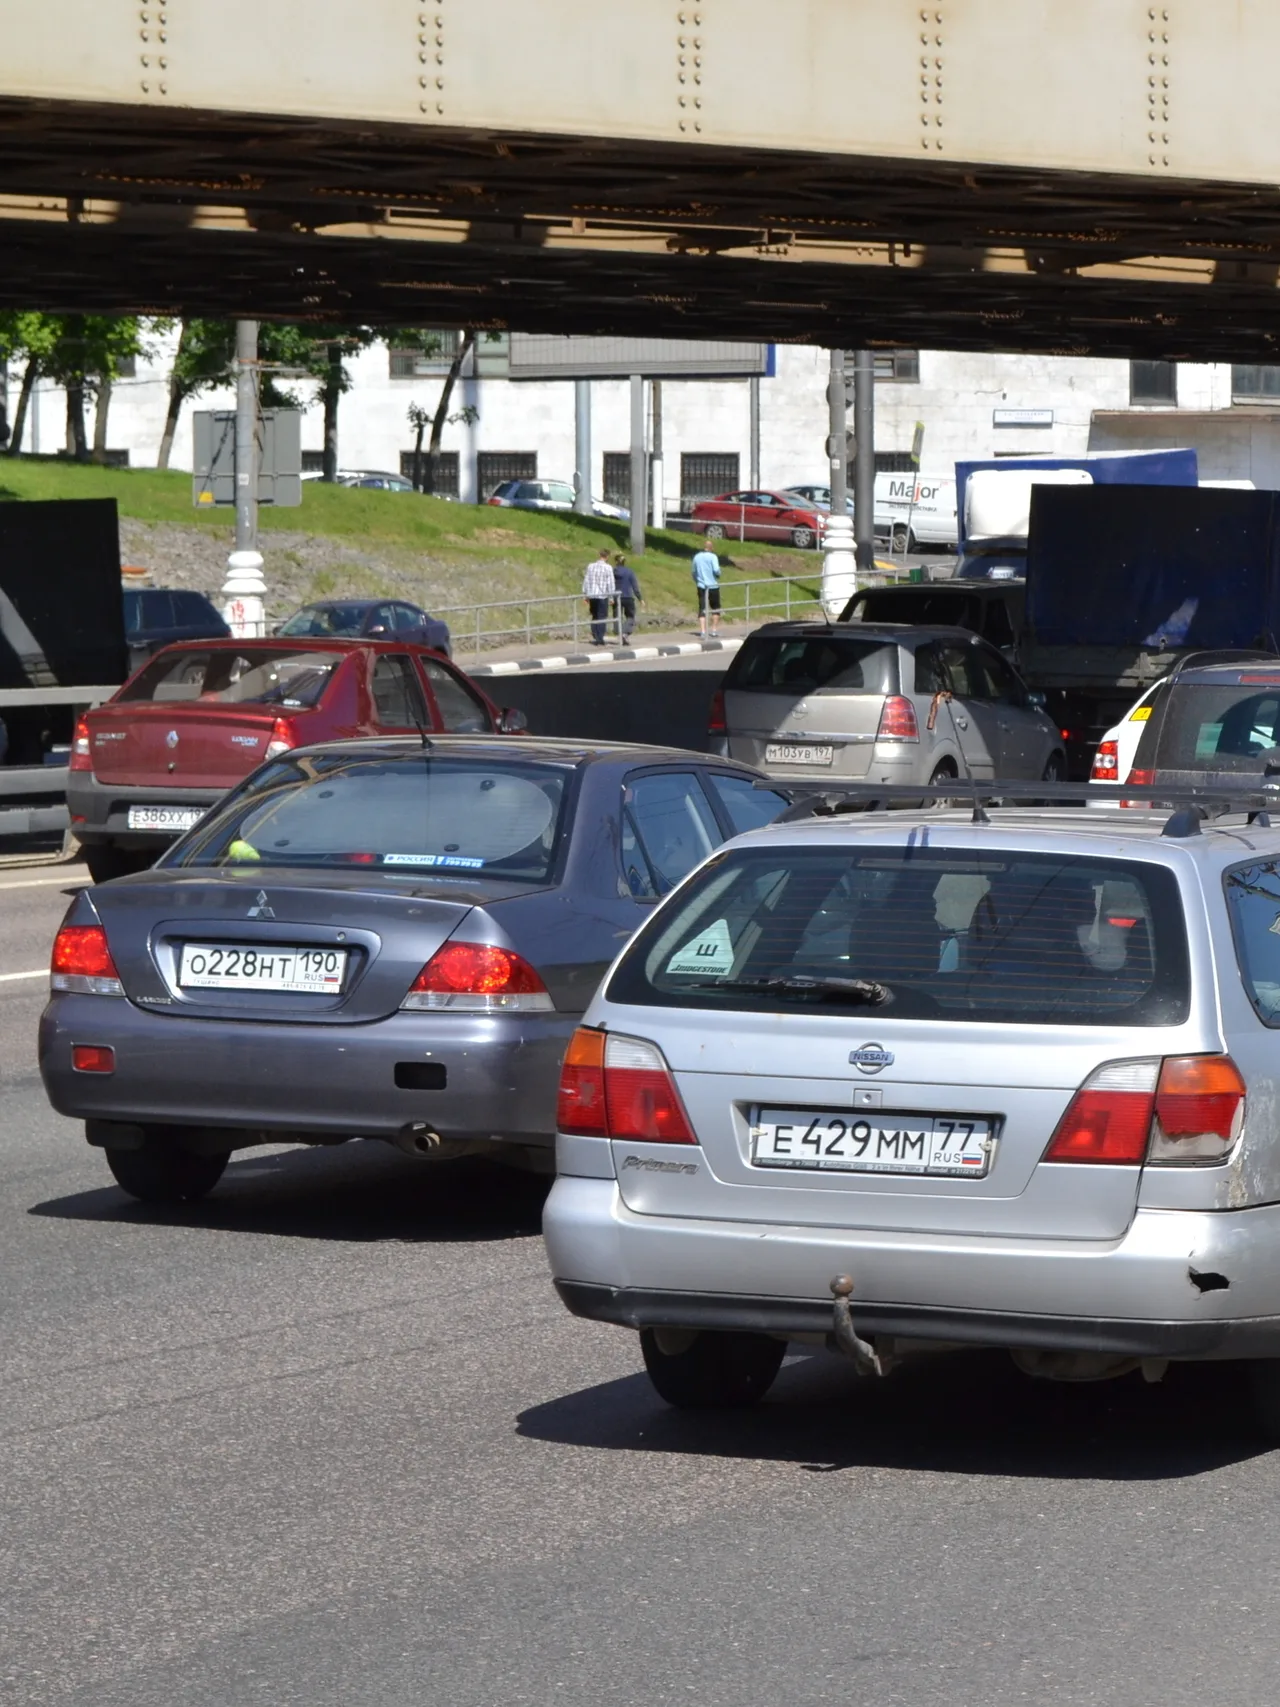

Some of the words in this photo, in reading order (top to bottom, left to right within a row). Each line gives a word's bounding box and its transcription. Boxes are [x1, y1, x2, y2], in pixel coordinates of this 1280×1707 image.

[889, 480, 939, 502] Major
[815, 747, 829, 757] 197
[397, 855, 434, 863] РОССИЯ
[300, 951, 337, 973] 190
[670, 963, 729, 974] BRIDGESTONE
[304, 973, 323, 982] RUS
[853, 1052, 889, 1062] NISSAN
[938, 1121, 976, 1151] 77
[934, 1152, 961, 1164] RUS
[621, 1155, 700, 1176] Primera
